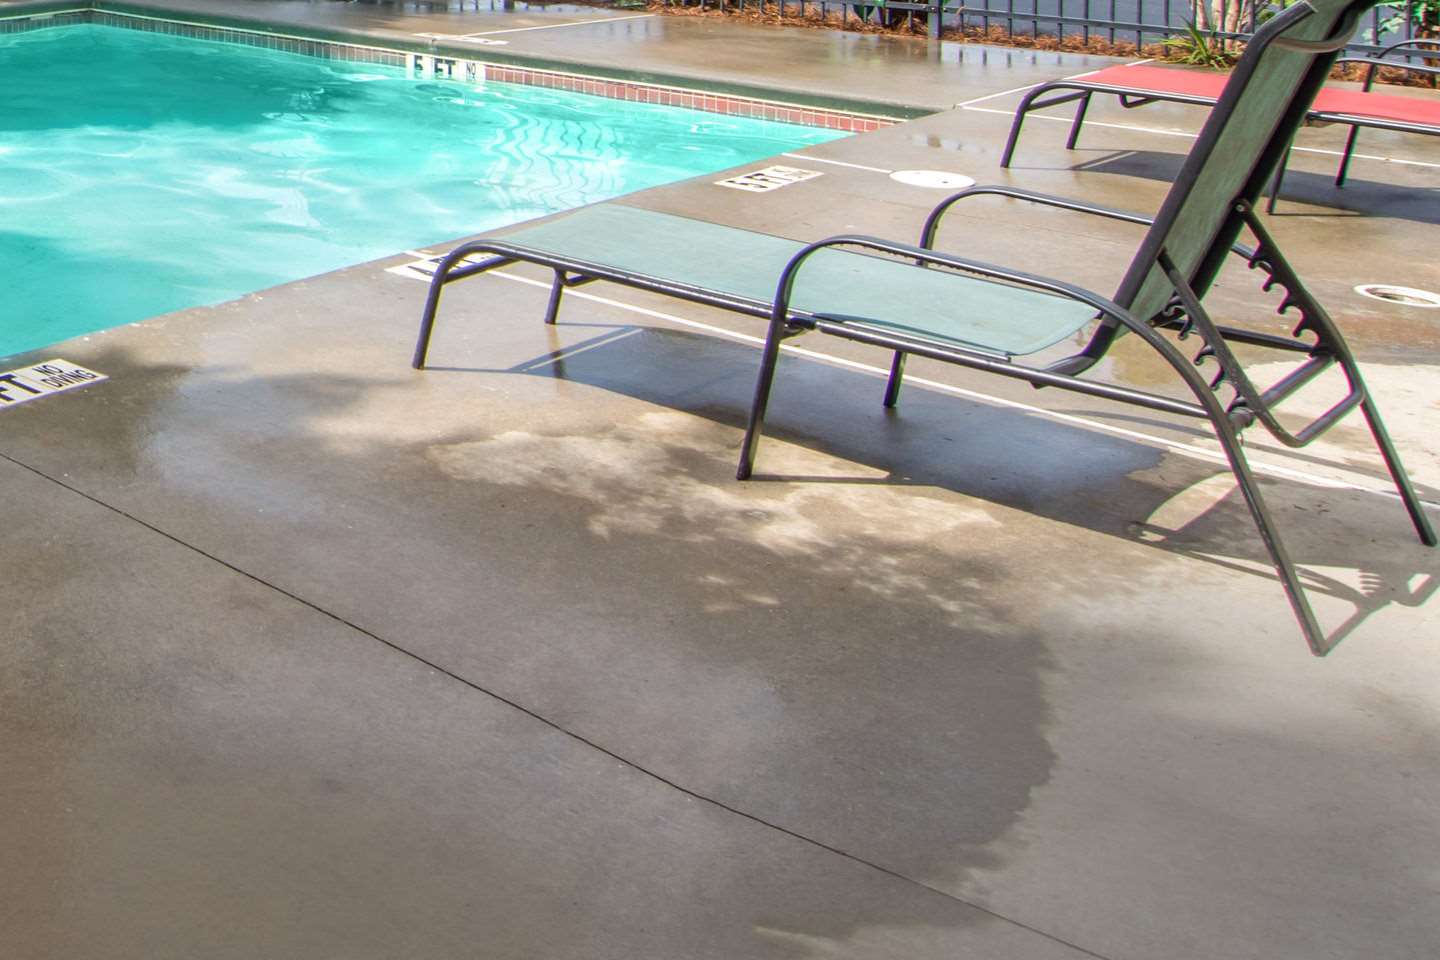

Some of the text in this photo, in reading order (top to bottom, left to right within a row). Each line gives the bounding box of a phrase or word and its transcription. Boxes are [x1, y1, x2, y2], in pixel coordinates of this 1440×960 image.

[433, 57, 457, 76] FT
[32, 364, 64, 377] NO
[40, 368, 98, 388] DIVING
